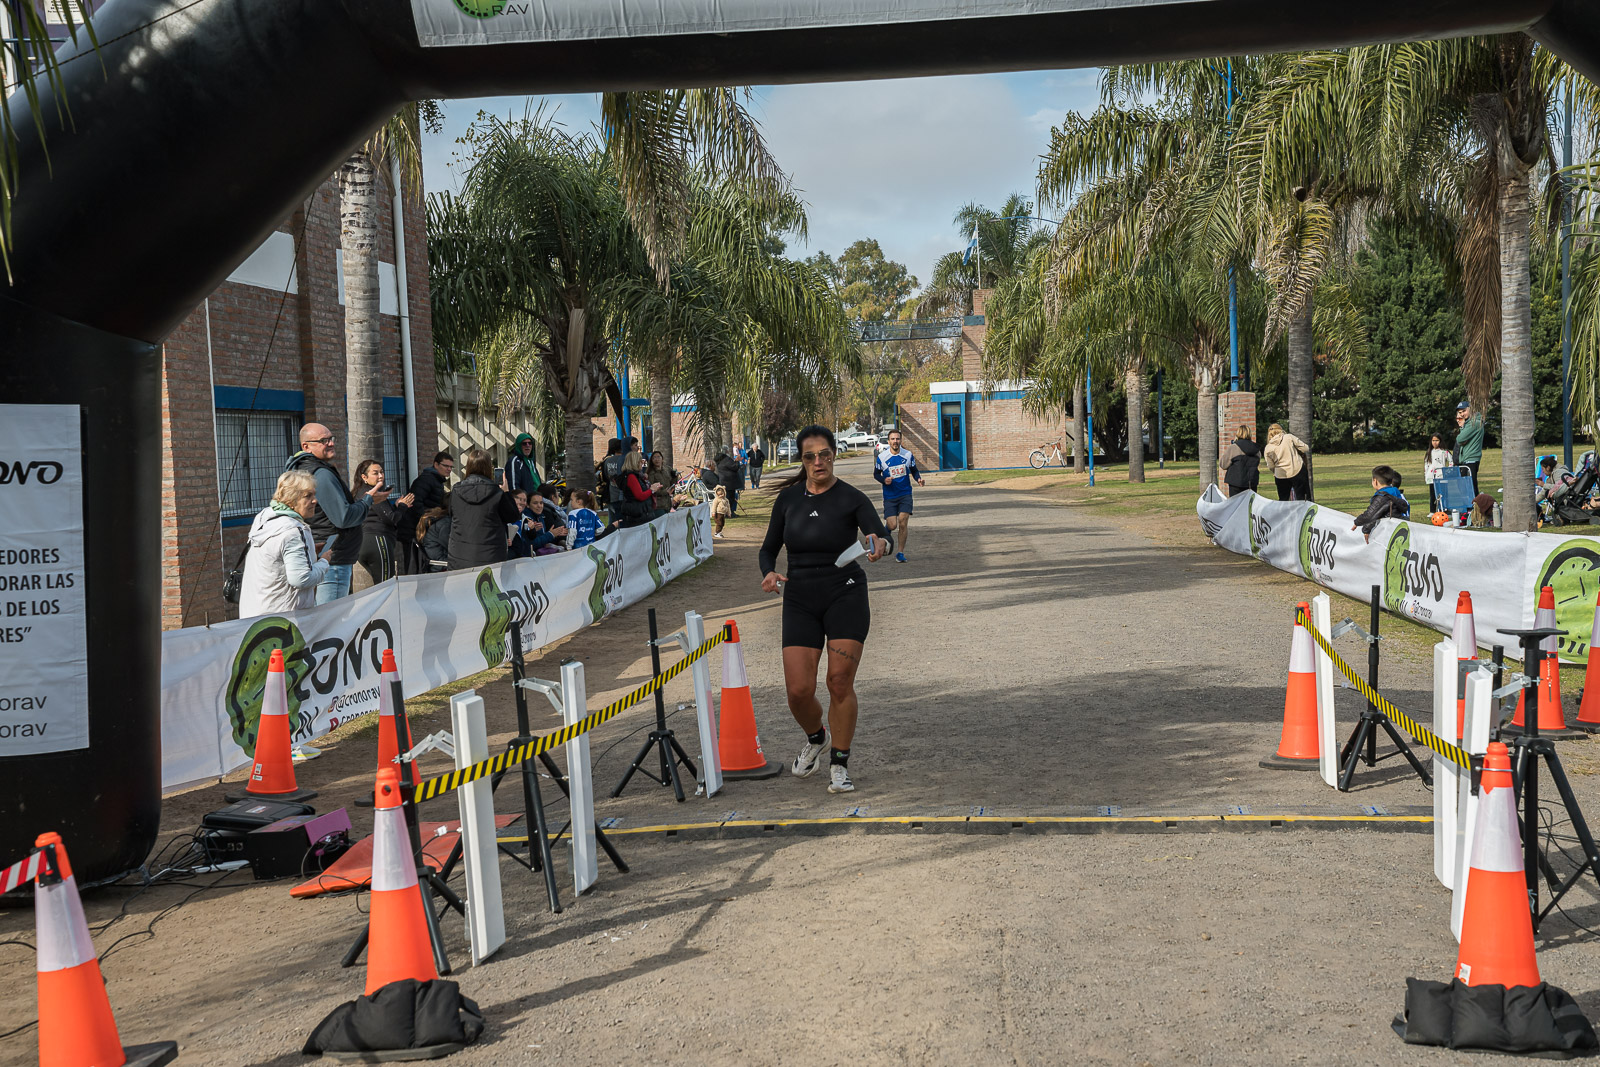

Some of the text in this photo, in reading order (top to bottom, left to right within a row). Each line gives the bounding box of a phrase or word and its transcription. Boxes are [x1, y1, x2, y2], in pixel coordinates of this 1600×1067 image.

[492, 4, 529, 16] RAV
[46, 573, 74, 589] LAS
[7, 601, 27, 617] DE
[32, 599, 60, 616] LOS
[0, 696, 47, 711] orav
[0, 723, 47, 738] orav
